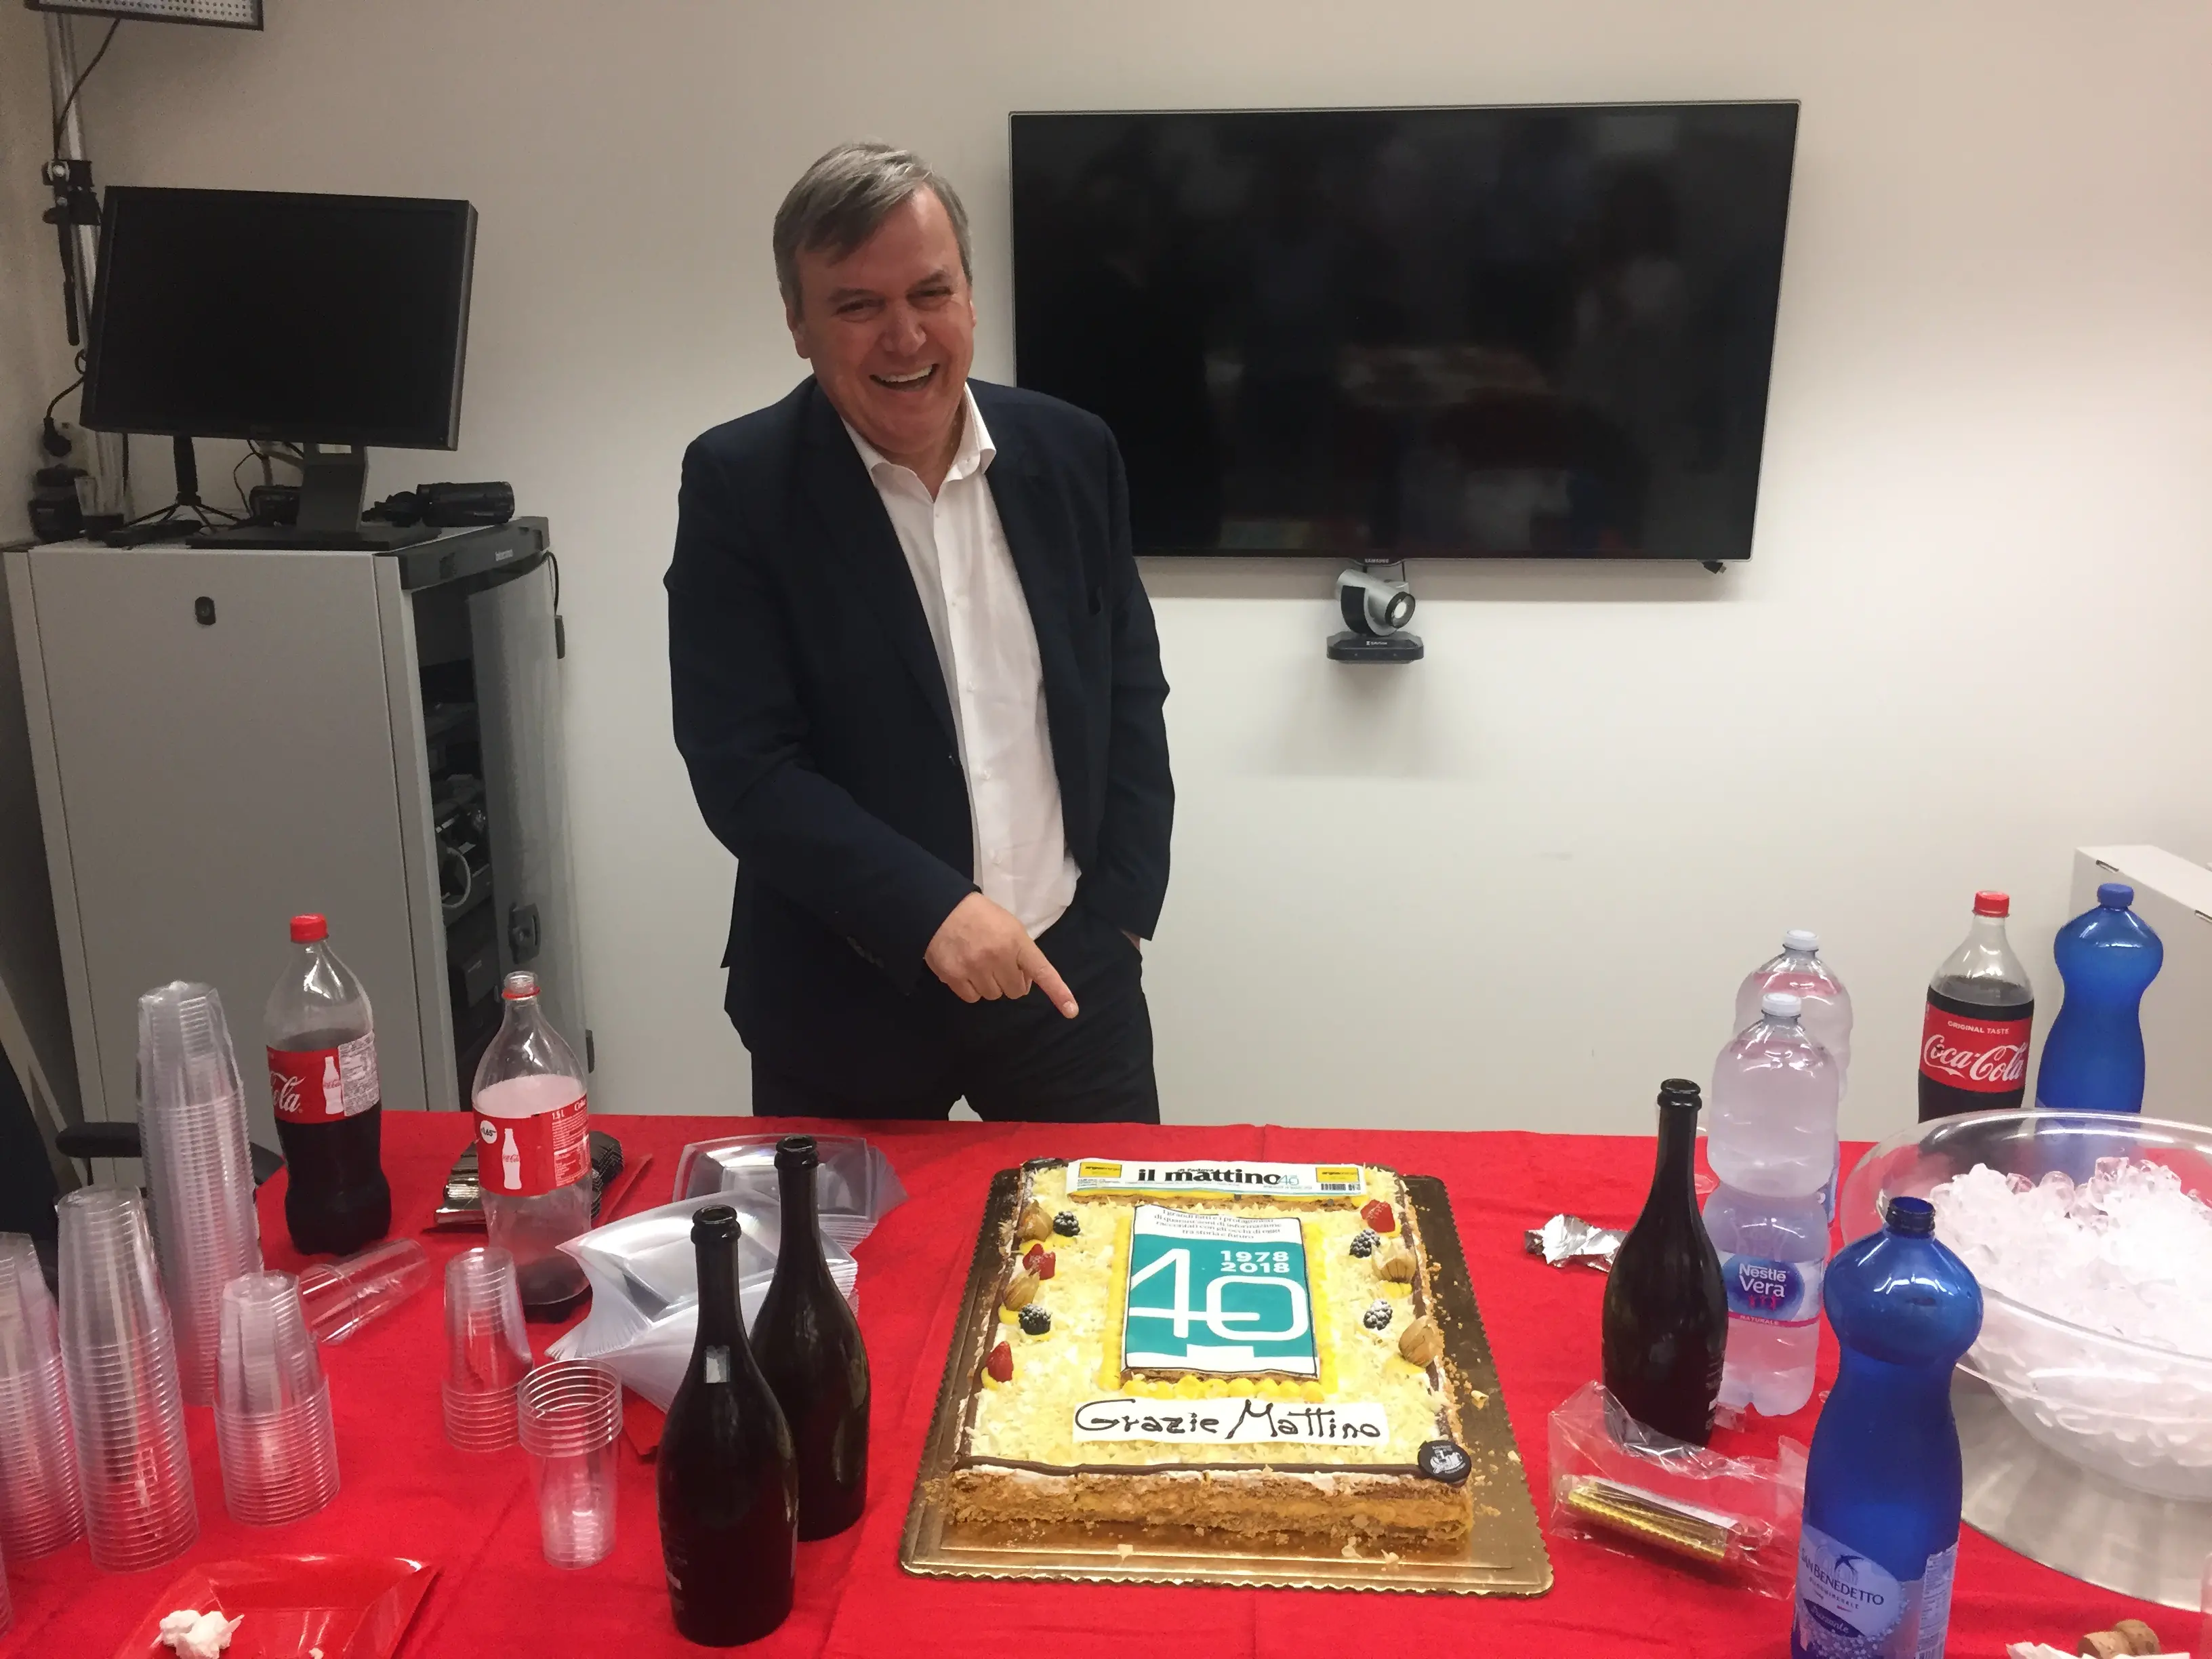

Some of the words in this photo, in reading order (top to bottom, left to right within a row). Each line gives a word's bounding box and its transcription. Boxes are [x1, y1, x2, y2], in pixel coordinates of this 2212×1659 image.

[1947, 1020, 1984, 1033] ORIGINAL
[1924, 1034, 2028, 1082] Coca-Cola
[1138, 1169, 1155, 1181] il
[1164, 1168, 1281, 1185] mattino
[1221, 1250, 1290, 1262] 1978
[1221, 1261, 1290, 1273] 2018
[1739, 1263, 1786, 1282] Nestlé
[1739, 1275, 1785, 1298] Vera
[1740, 1315, 1779, 1326] NATURALE
[1075, 1398, 1220, 1433] Grazie
[1225, 1399, 1381, 1439] Mattino
